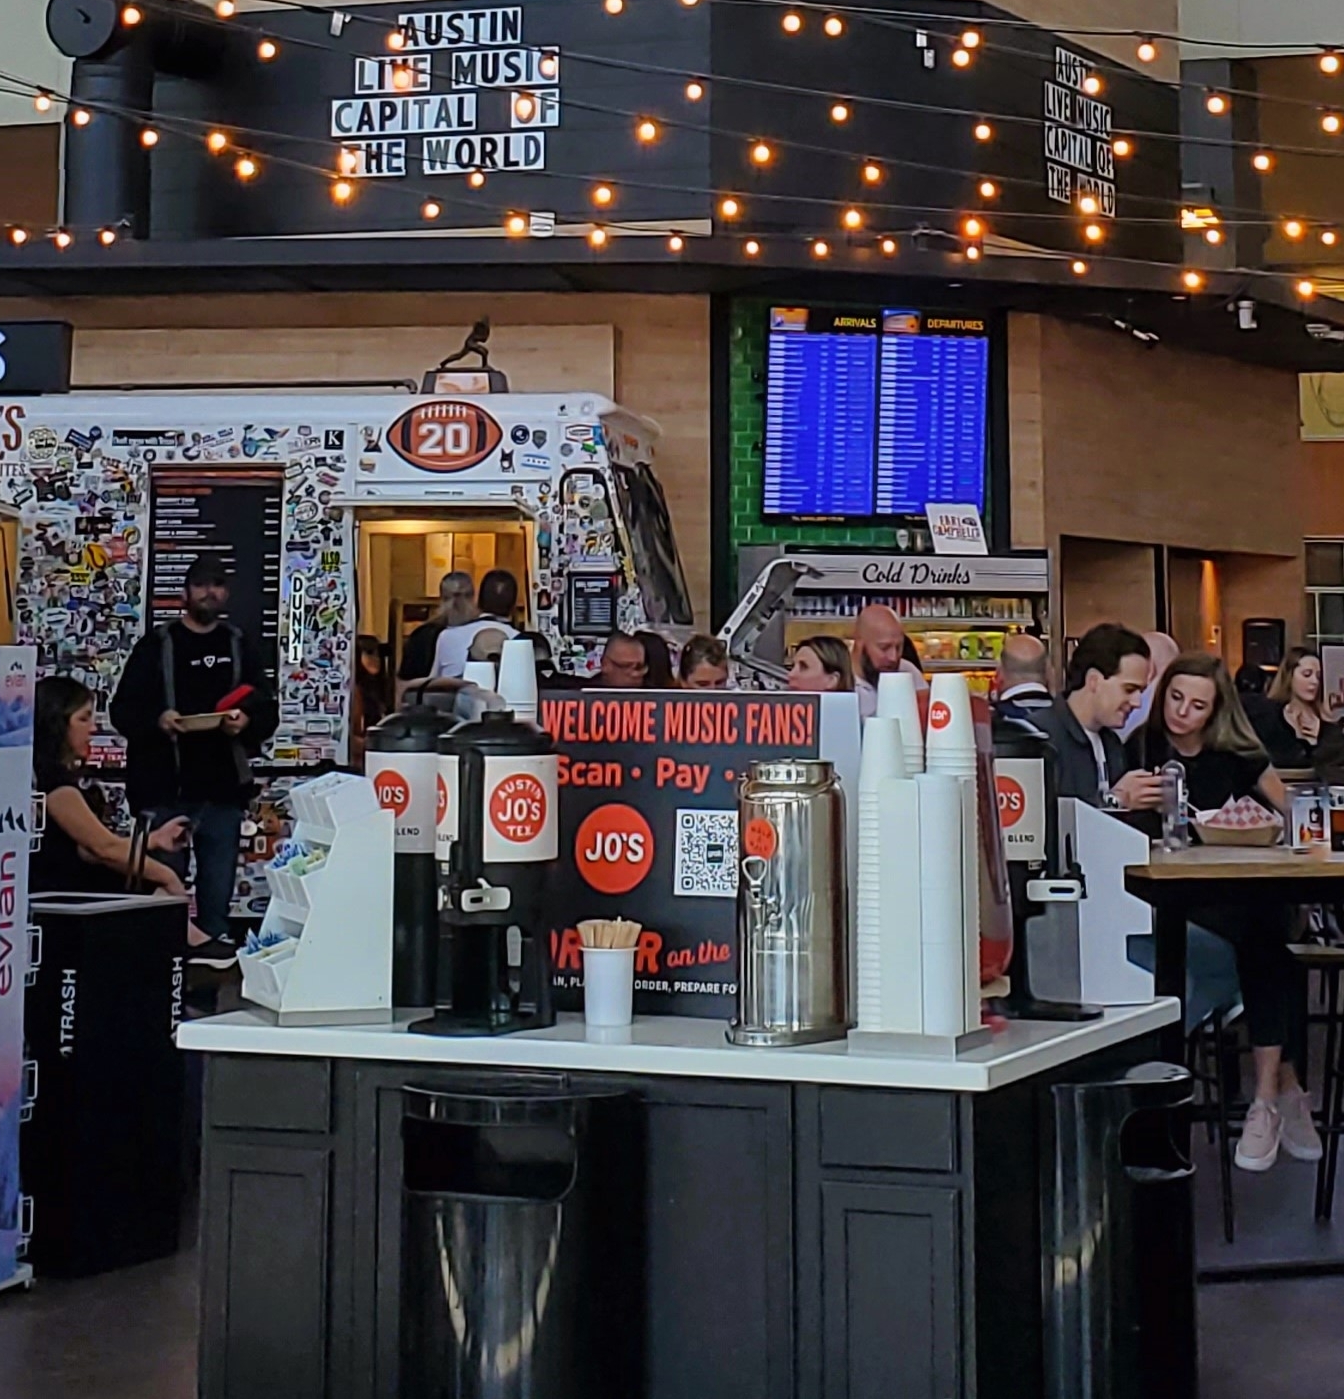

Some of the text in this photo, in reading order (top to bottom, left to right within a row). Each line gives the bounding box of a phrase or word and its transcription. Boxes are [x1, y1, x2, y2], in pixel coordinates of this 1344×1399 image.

[403, 10, 520, 47] AUSTIN
[334, 96, 475, 133] CAPITAL
[343, 134, 542, 175] HE WORLD
[1048, 164, 1070, 203] THE
[833, 316, 877, 329] ARRIVALS
[927, 318, 984, 331] DEPARTURES
[328, 430, 340, 446] K
[417, 422, 471, 456] 20
[862, 561, 971, 585] Cold Drinks
[542, 699, 813, 747] WELCOME MUSIC FANS!
[497, 778, 543, 800] AUSTIN
[556, 754, 711, 795] Scan Pay
[496, 797, 541, 822] JO'S
[584, 831, 645, 863] JO'S
[1008, 834, 1035, 843] BLEND
[666, 948, 695, 969] on
[697, 939, 731, 965] the
[171, 956, 184, 1030] TRASH
[673, 982, 720, 994] PREPARE
[60, 968, 78, 1044] TRASH
